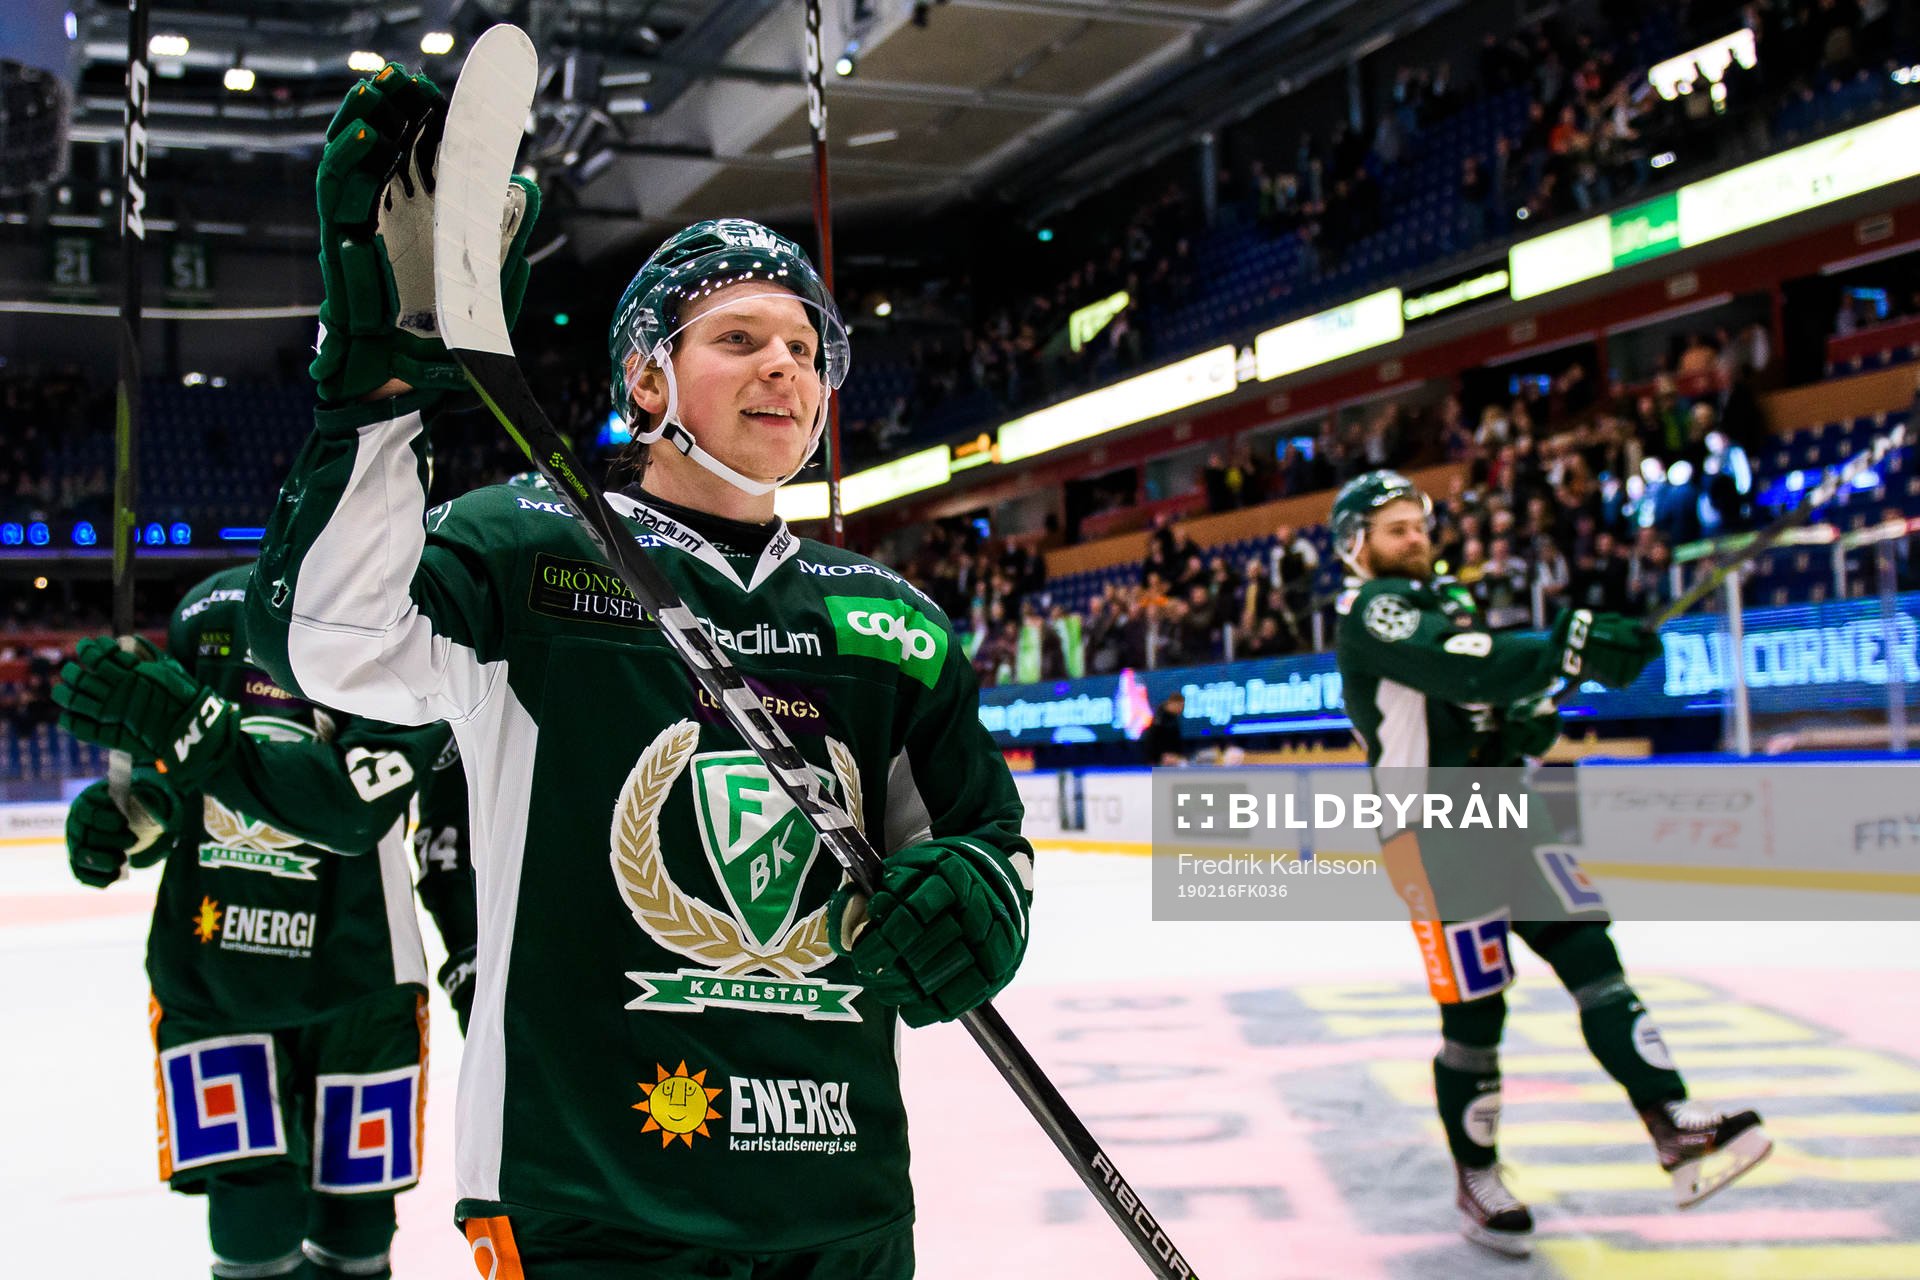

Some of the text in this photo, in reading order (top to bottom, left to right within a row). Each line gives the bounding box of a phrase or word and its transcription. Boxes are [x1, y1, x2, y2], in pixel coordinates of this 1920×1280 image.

[127, 59, 148, 240] CCM
[558, 460, 590, 500] sigmatex
[629, 506, 704, 553] stadium
[543, 566, 636, 600] GRÖNSA
[573, 593, 645, 621] HUSET
[847, 611, 936, 661] coop
[222, 905, 316, 948] ENERGI
[690, 979, 820, 1002] KARLSTAD
[729, 1076, 857, 1135] ENERGI
[729, 1135, 857, 1155] karlstadsenergi.se
[1091, 1151, 1192, 1280] RIBCOR
